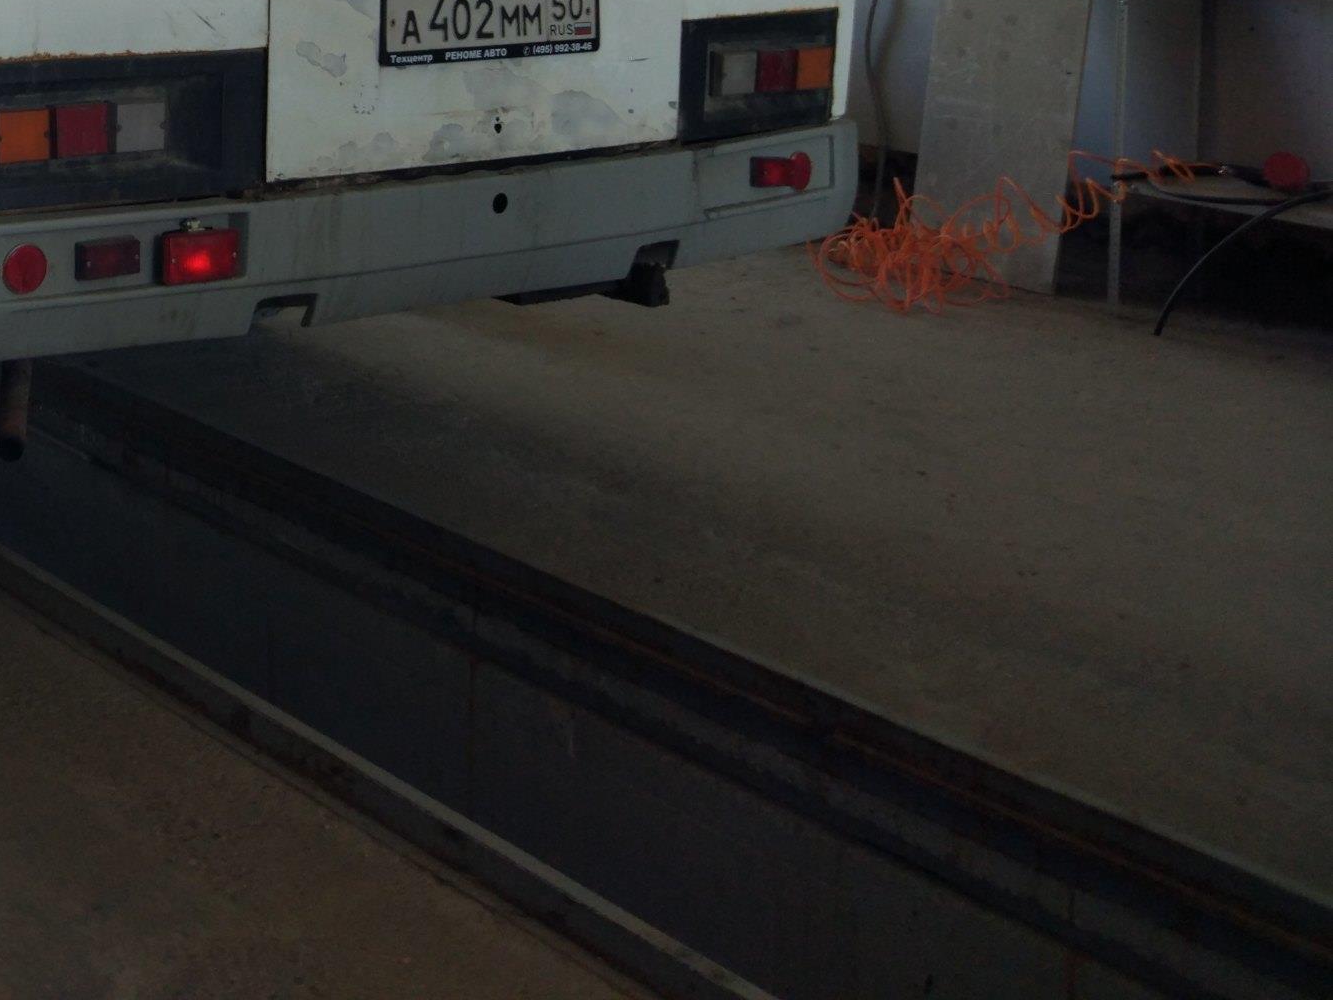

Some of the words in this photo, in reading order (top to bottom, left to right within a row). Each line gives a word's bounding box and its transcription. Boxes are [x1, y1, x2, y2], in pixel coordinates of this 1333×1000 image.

[550, 23, 573, 36] RUS
[390, 53, 433, 65] Техцентр
[445, 49, 482, 61] РЕНОМЕ
[483, 48, 507, 59] АВТО
